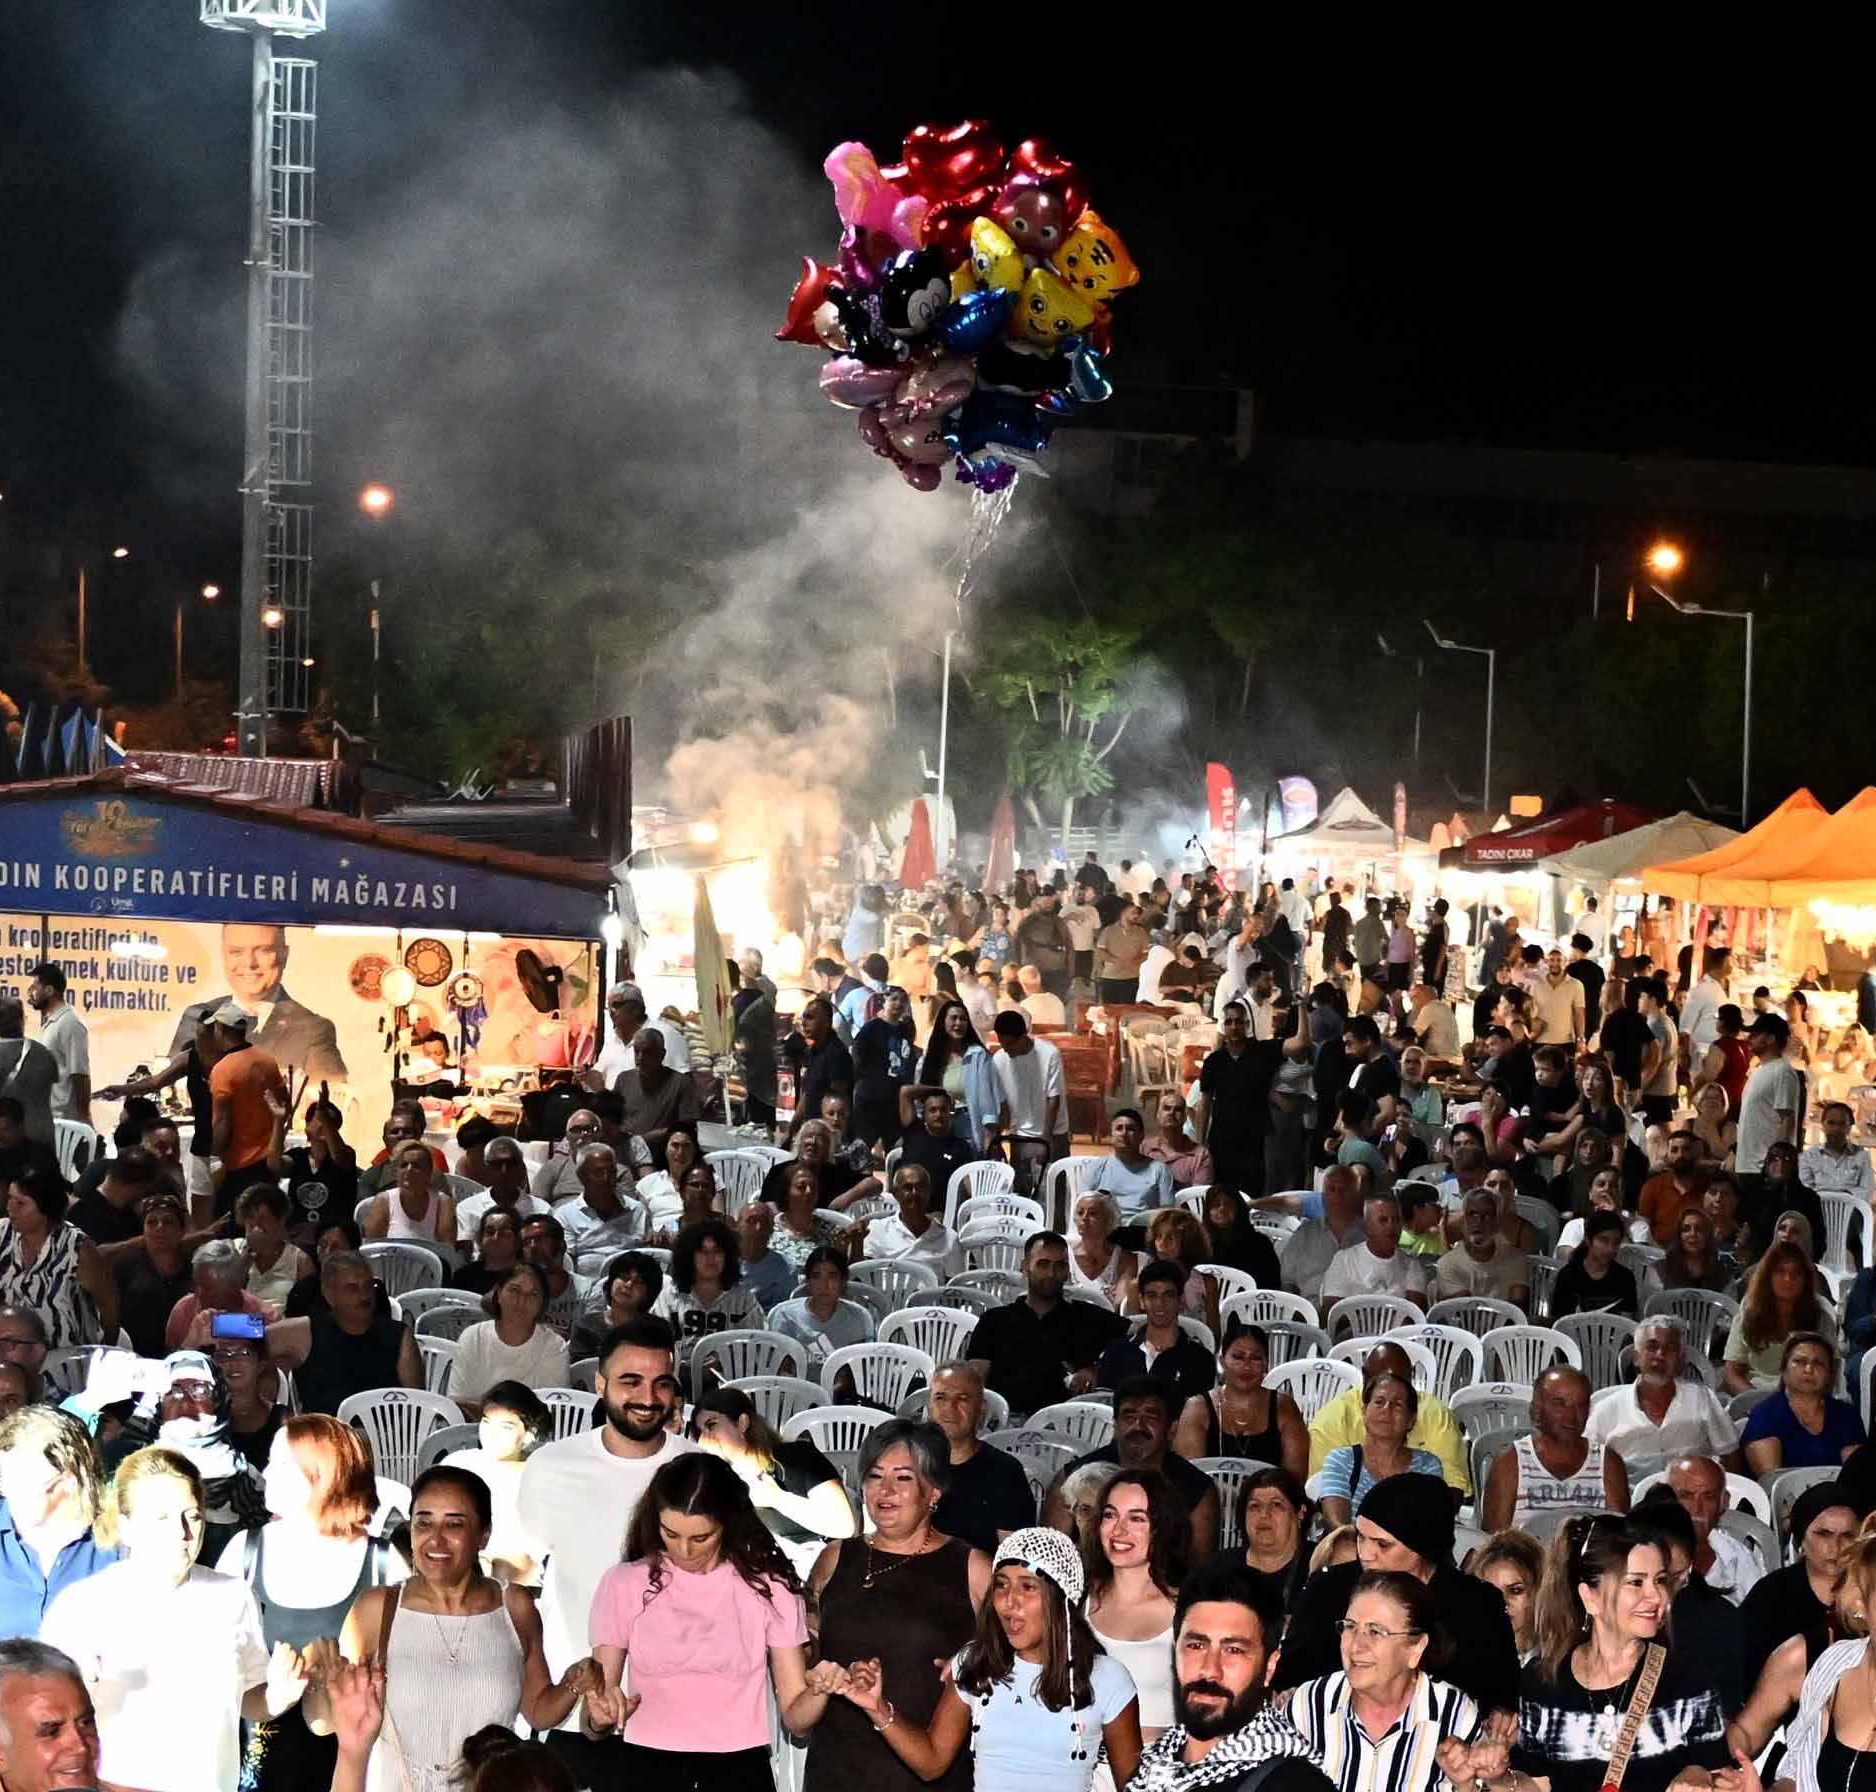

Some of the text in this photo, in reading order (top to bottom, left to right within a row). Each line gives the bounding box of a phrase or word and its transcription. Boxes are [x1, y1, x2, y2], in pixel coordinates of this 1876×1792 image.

[54, 863, 298, 901] KOOPERATİFLERİ
[311, 872, 458, 911] MAĞAZASI
[176, 965, 197, 985] ve
